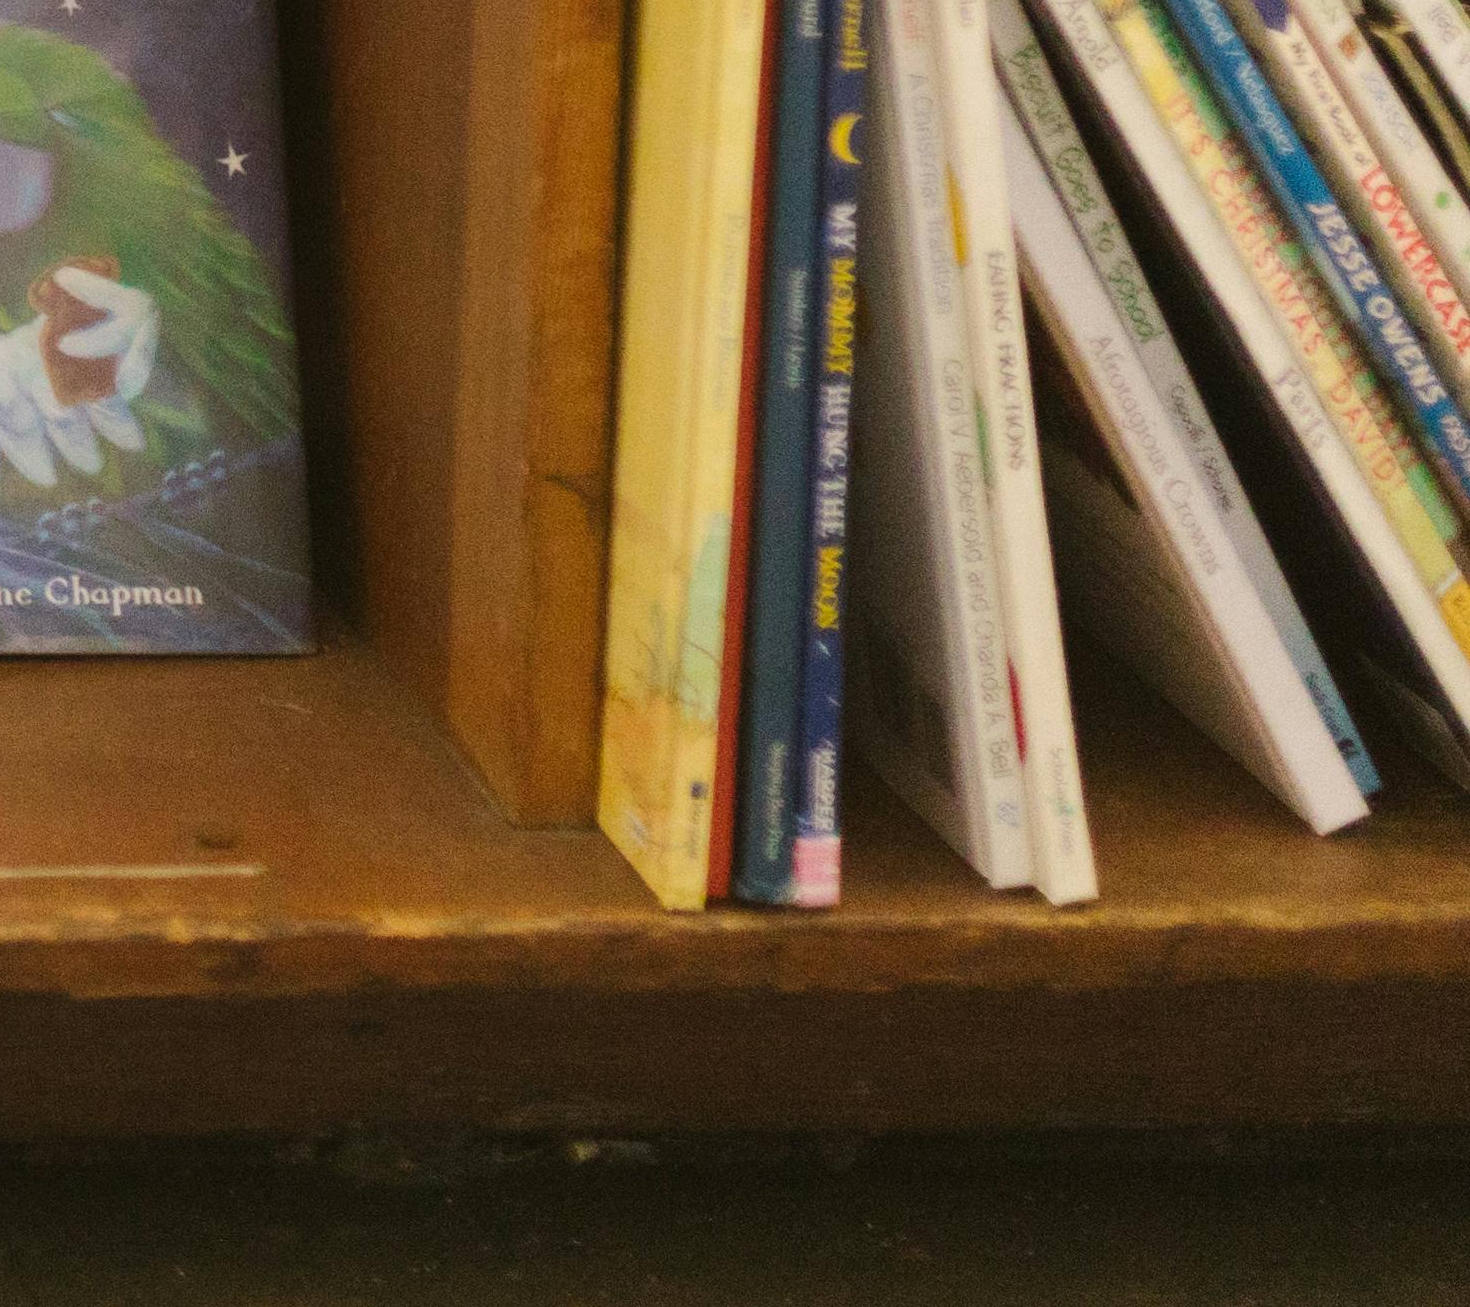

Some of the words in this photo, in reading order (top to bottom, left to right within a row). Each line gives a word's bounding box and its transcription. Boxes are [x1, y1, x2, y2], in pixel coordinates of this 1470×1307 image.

[910, 93, 944, 208] Christmas
[1230, 64, 1298, 159] Velasquez
[826, 201, 858, 250] MY
[1006, 43, 1072, 139] Biscuit
[1053, 146, 1103, 213] Goes
[1088, 218, 1122, 255] to
[1107, 258, 1164, 341] School
[788, 269, 810, 327] Sanders
[925, 216, 957, 315] Tradition
[985, 250, 1014, 334] EATING
[1307, 194, 1378, 292] JESSE
[1365, 291, 1446, 408] OWENS
[824, 257, 858, 374] MOMMY
[785, 344, 806, 388] Lewis
[940, 357, 968, 417] Carol
[994, 342, 1030, 471] FRACTIONS
[1272, 366, 1334, 449] Parts
[817, 382, 851, 469] HUNG
[816, 473, 847, 539] THE
[952, 449, 987, 563] Aebersold
[1161, 476, 1226, 576] Crowns
[42, 575, 206, 611] Chapman
[810, 544, 843, 629] MOON
[967, 569, 992, 612] and
[972, 619, 1004, 705] Chanda
[812, 746, 837, 831] HARPER
[986, 737, 1014, 781] Bell
